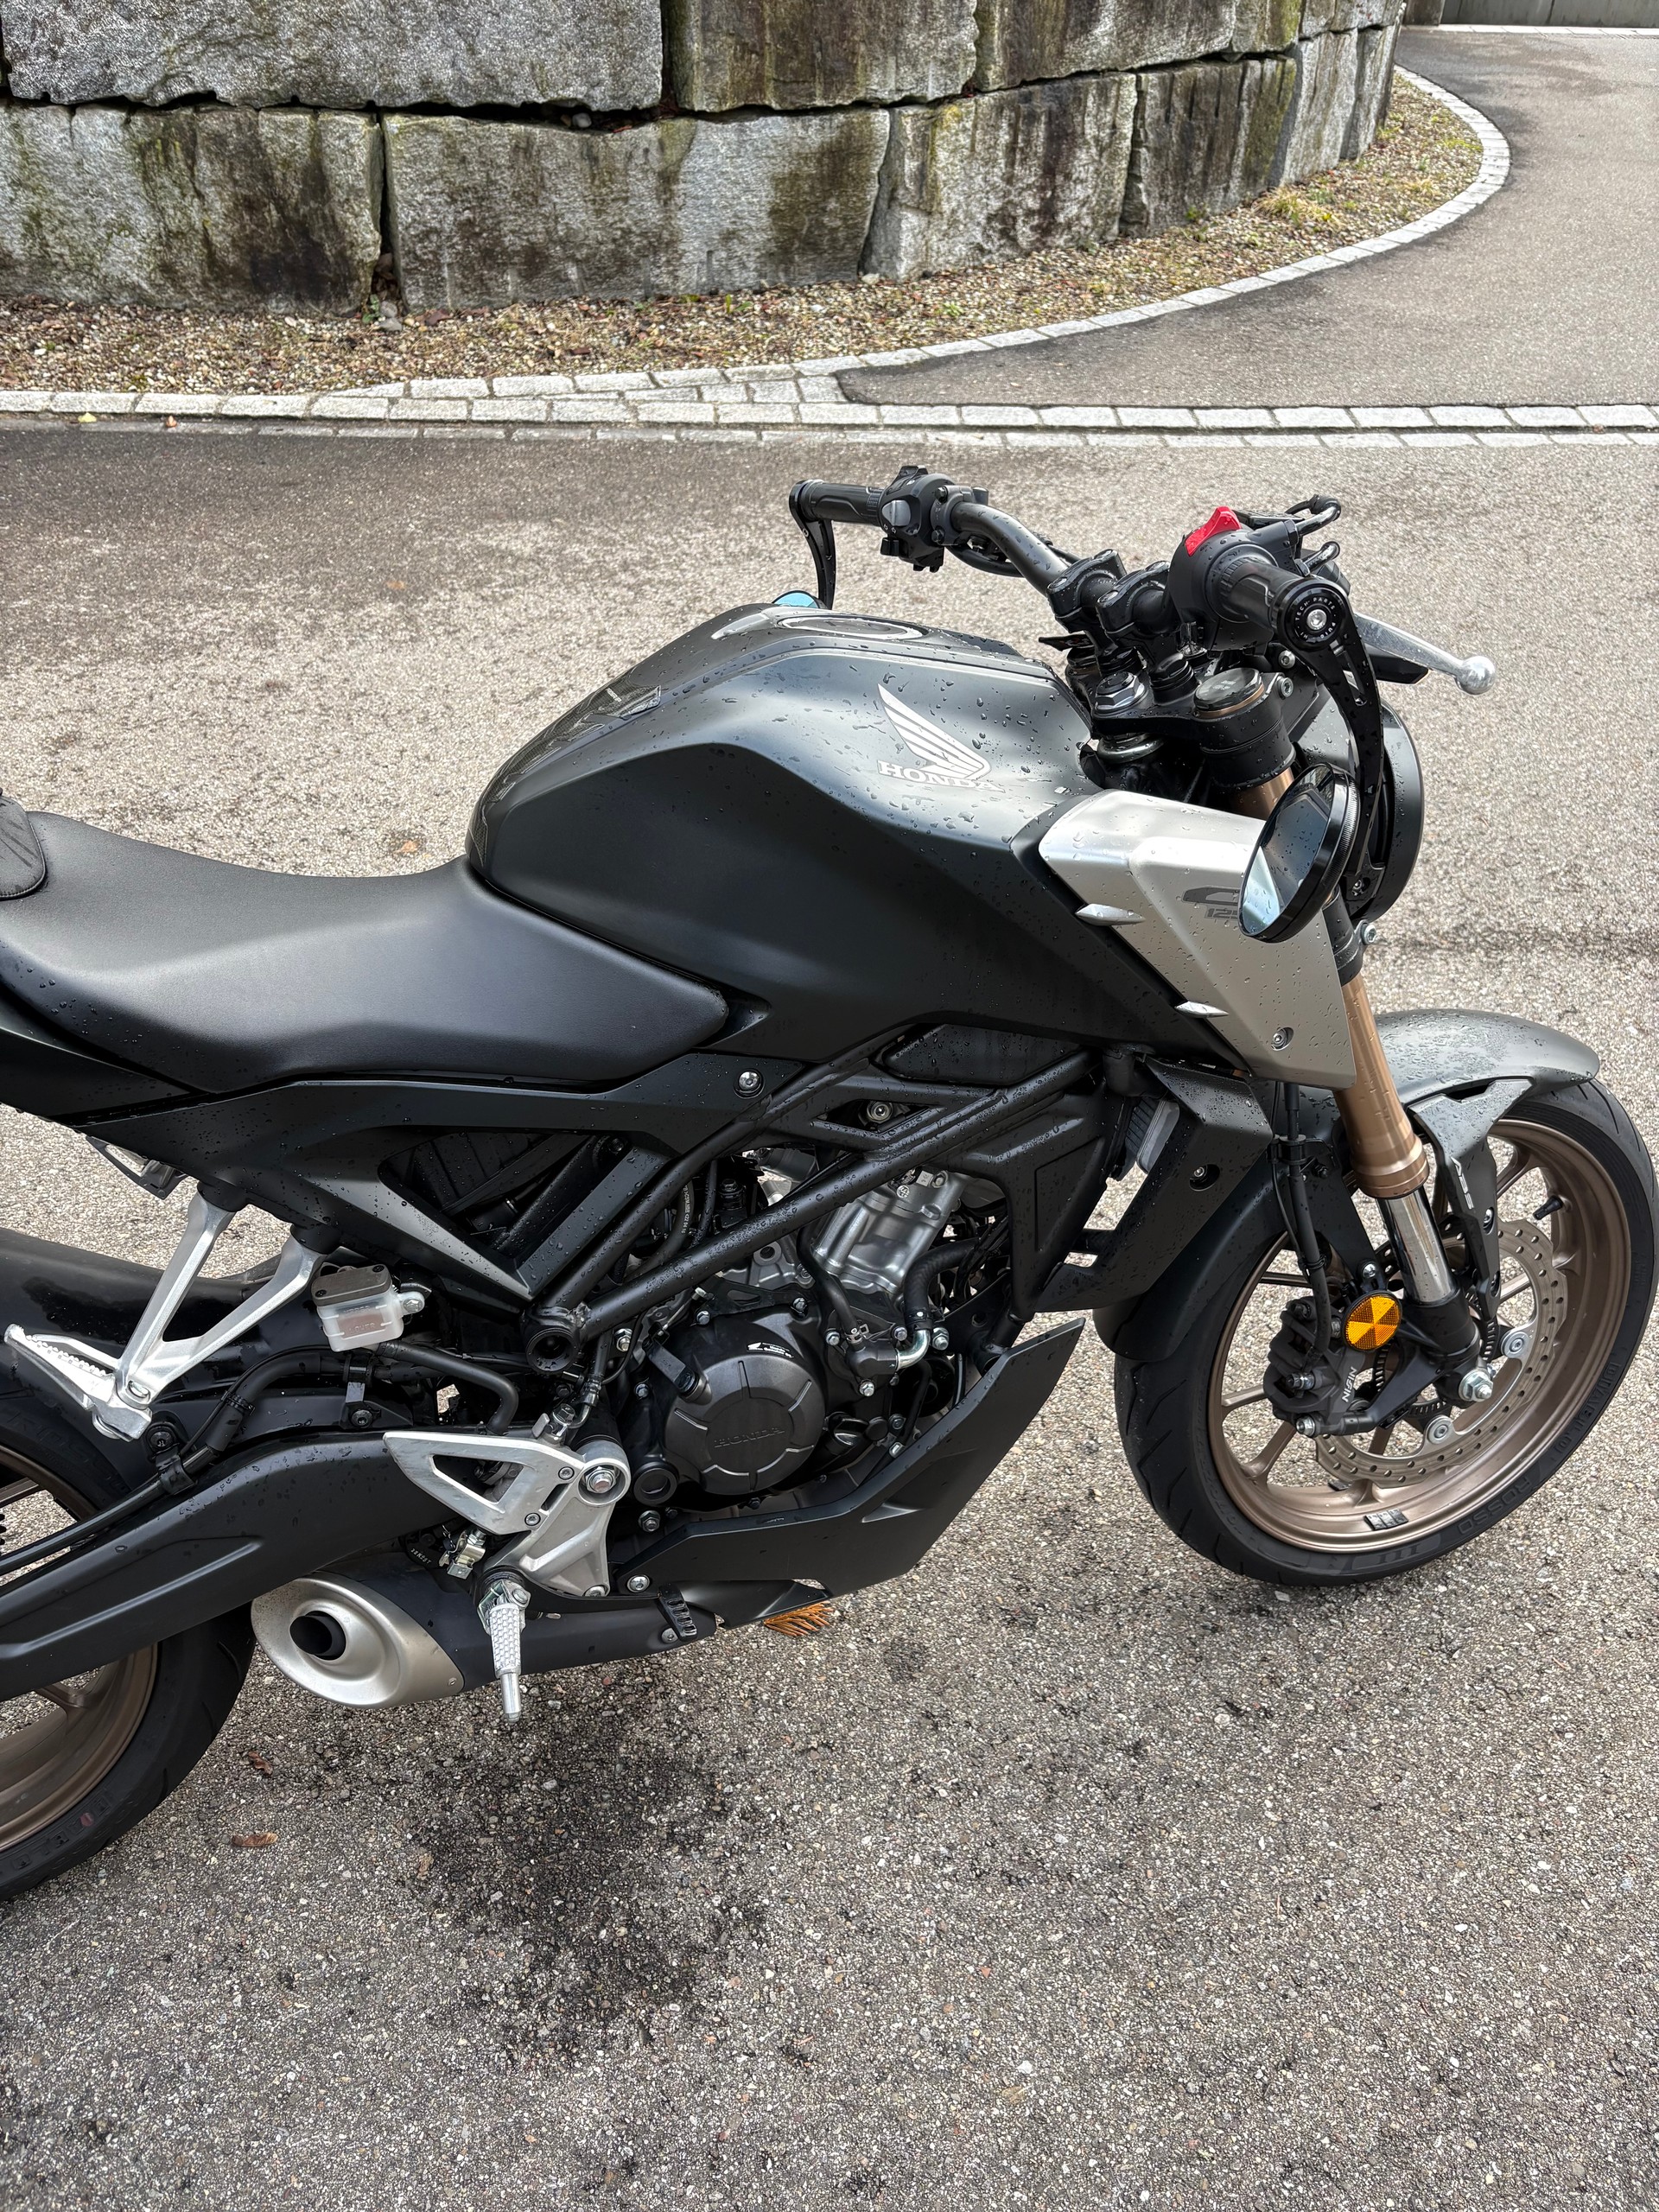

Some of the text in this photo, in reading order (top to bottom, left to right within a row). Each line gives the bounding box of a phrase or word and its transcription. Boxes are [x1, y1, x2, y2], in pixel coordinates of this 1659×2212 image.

[1313, 597, 1336, 610] PARTS
[876, 760, 1006, 793] HONDA
[1341, 1366, 1357, 1402] NISSIN
[714, 1427, 785, 1448] HONDA
[1457, 1476, 1535, 1535] ROSSO
